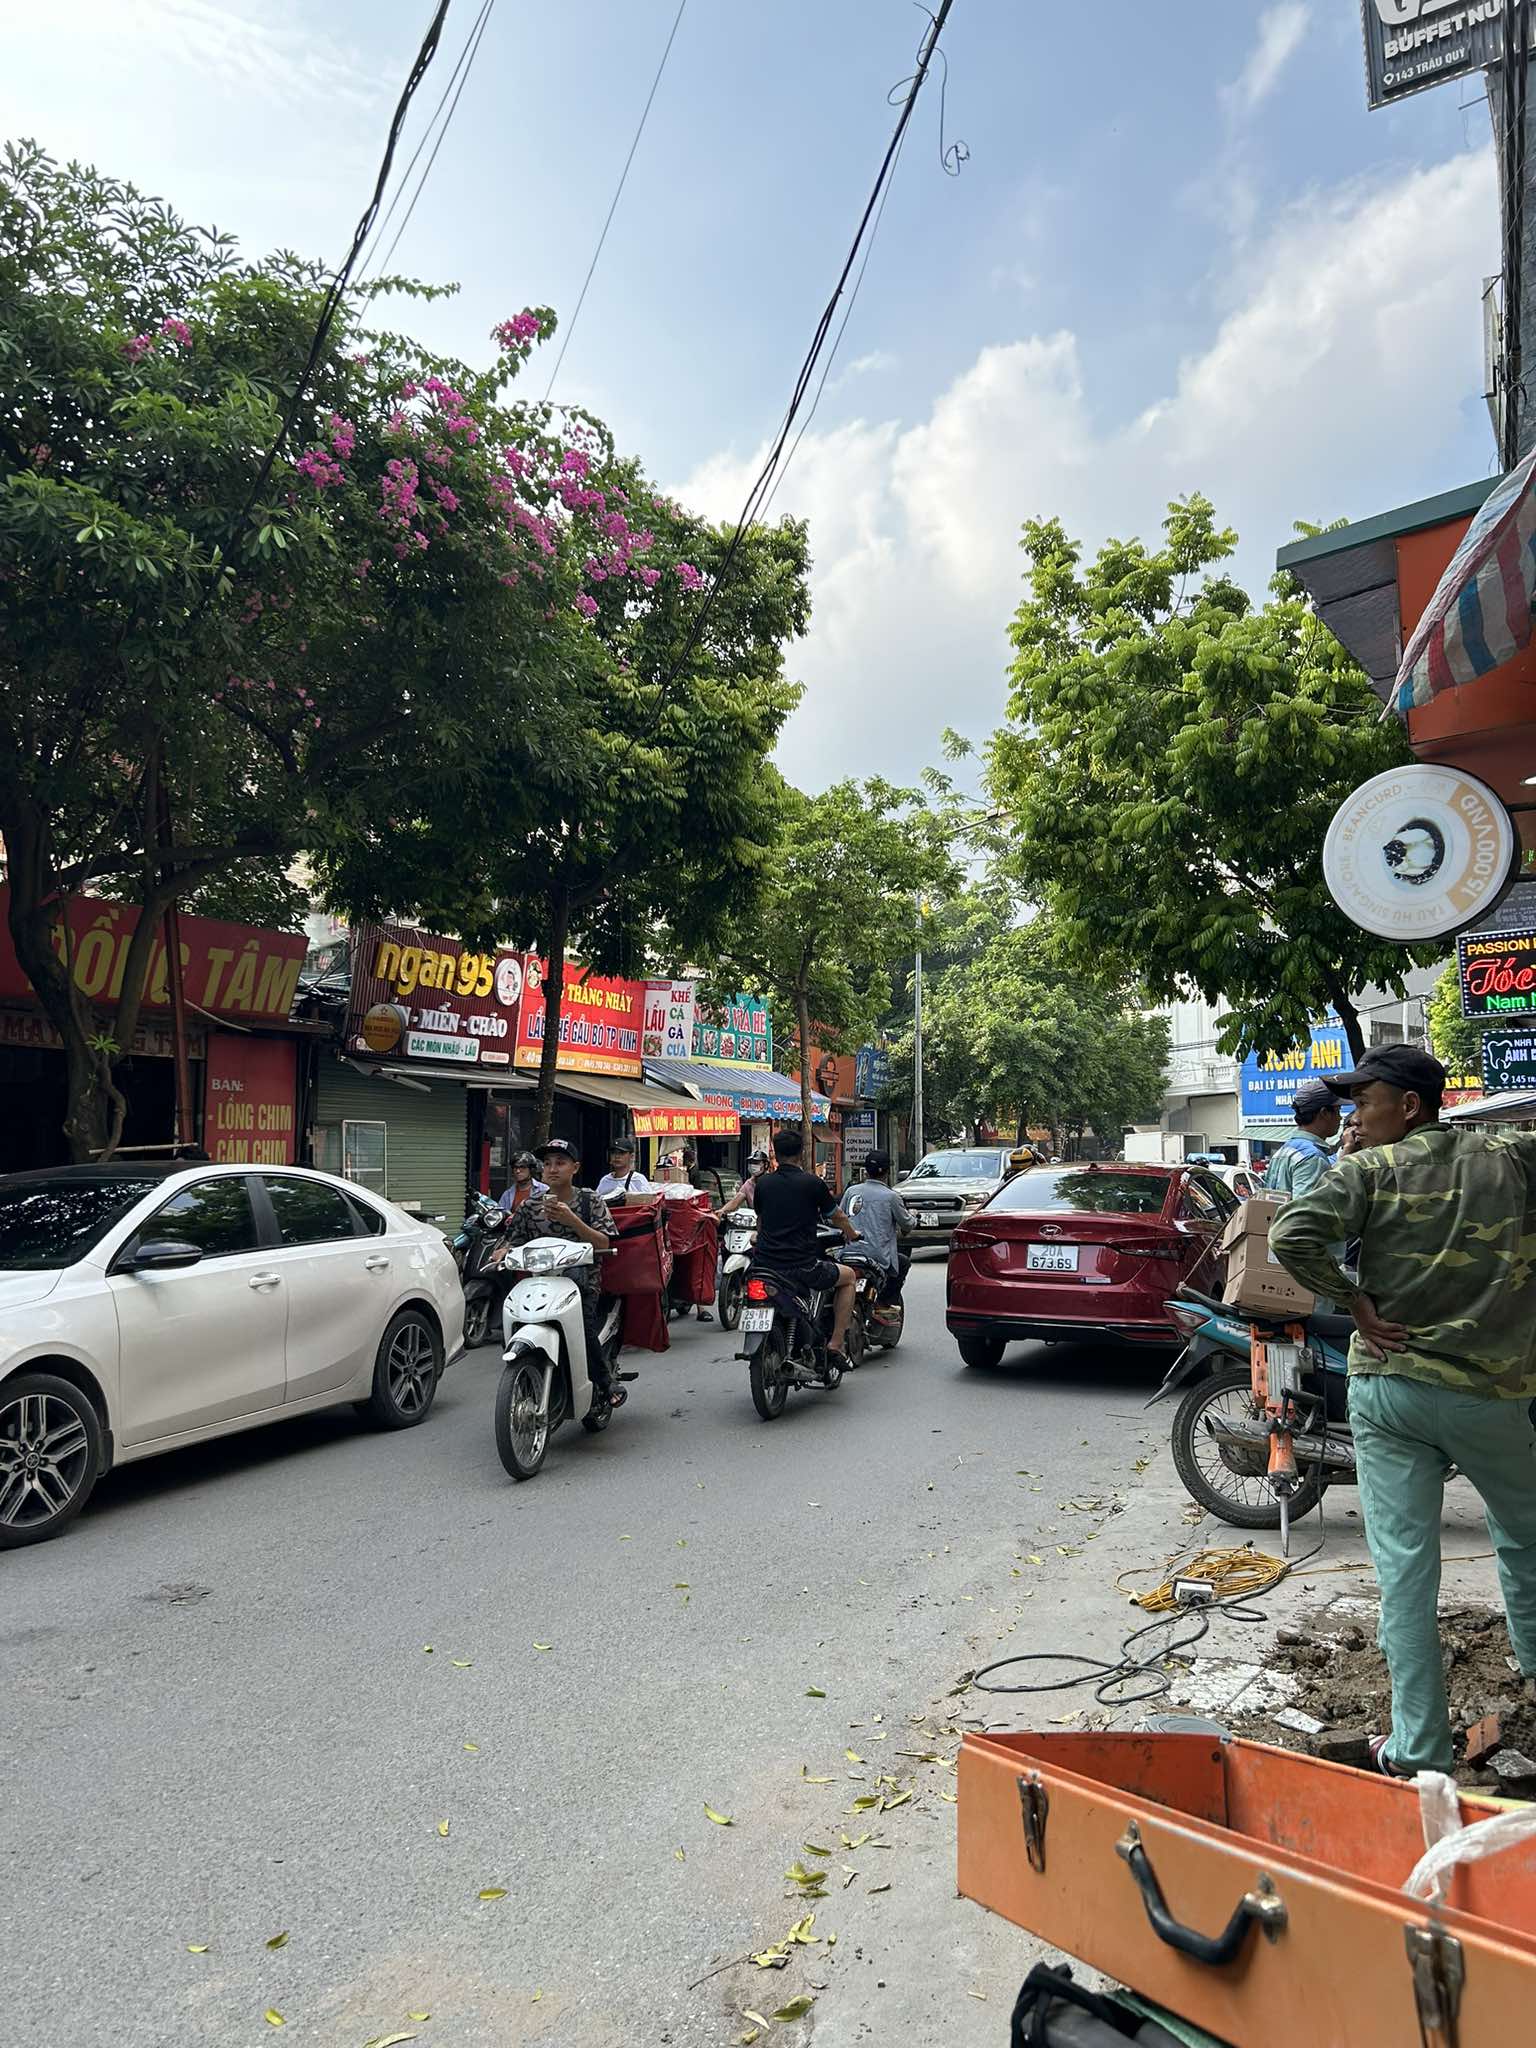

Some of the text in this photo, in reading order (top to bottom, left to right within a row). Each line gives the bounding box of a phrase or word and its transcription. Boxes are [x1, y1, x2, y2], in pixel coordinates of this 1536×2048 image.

[1396, 68, 1415, 83] 143
[201, 938, 302, 1016] TÂM
[1486, 994, 1526, 1010] Nam
[669, 1005, 685, 1020] CÁ
[605, 1024, 617, 1049] TP
[618, 1028, 639, 1053] VINH
[668, 1023, 684, 1039] GÀ
[1311, 1039, 1342, 1070] ANH
[1248, 1080, 1264, 1094] ĐẠI
[1265, 1078, 1275, 1090] LÝ
[1511, 1074, 1526, 1084] 145
[258, 1104, 292, 1131] CHIM
[253, 1140, 288, 1165] CHIM
[1040, 1244, 1064, 1257] 20A
[1032, 1257, 1072, 1269] 673.69
